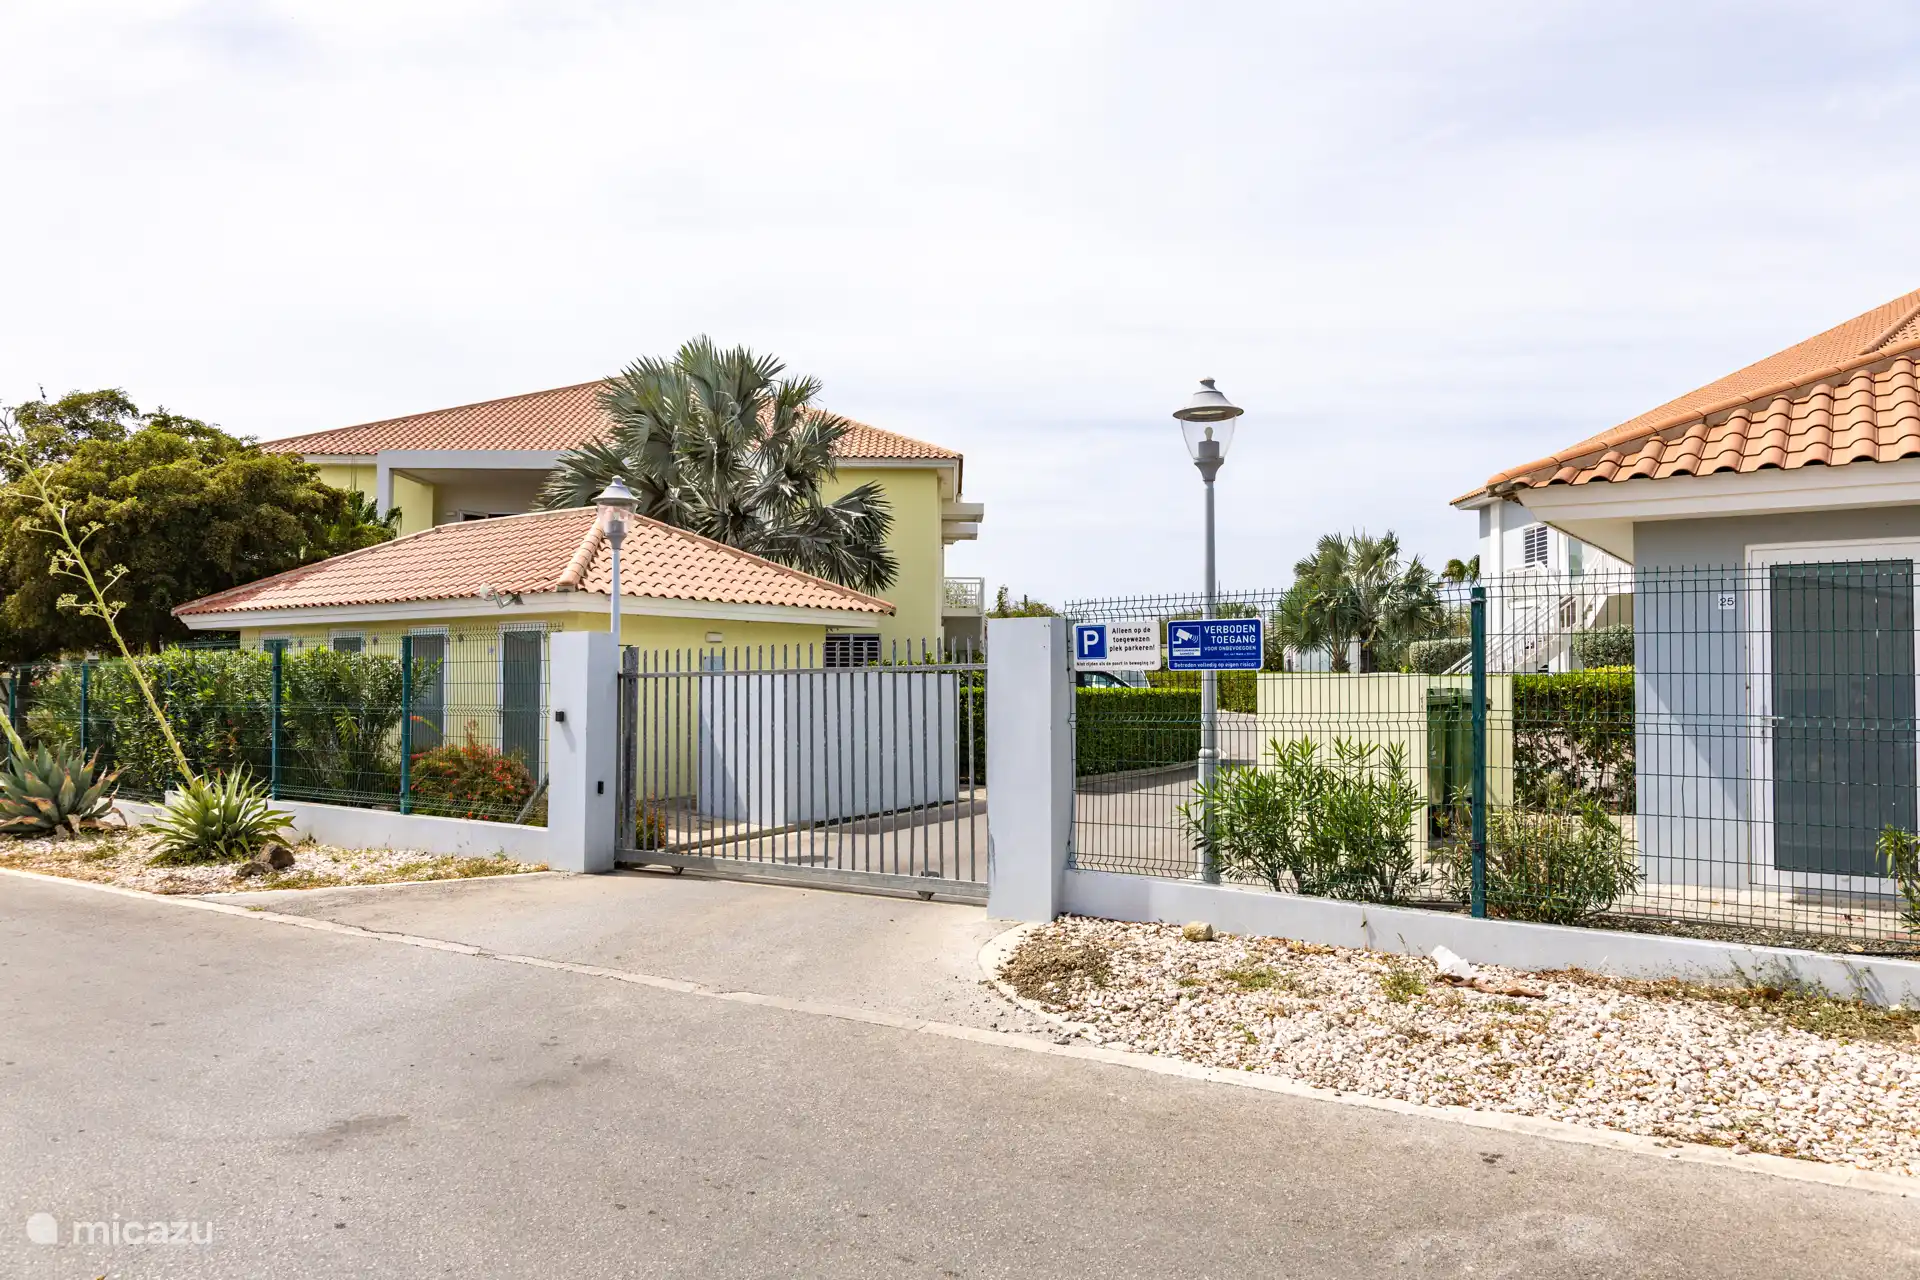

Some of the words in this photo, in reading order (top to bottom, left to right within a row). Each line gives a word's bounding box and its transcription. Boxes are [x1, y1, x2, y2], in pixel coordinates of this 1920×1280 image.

[1719, 597, 1734, 606] 25
[1204, 625, 1256, 634] VERBODEN
[1084, 630, 1099, 655] P
[1113, 636, 1151, 644] toegewezen
[1211, 635, 1256, 644] TOEGANG
[1124, 644, 1155, 652] parkeren!
[1225, 661, 1239, 669] eigen
